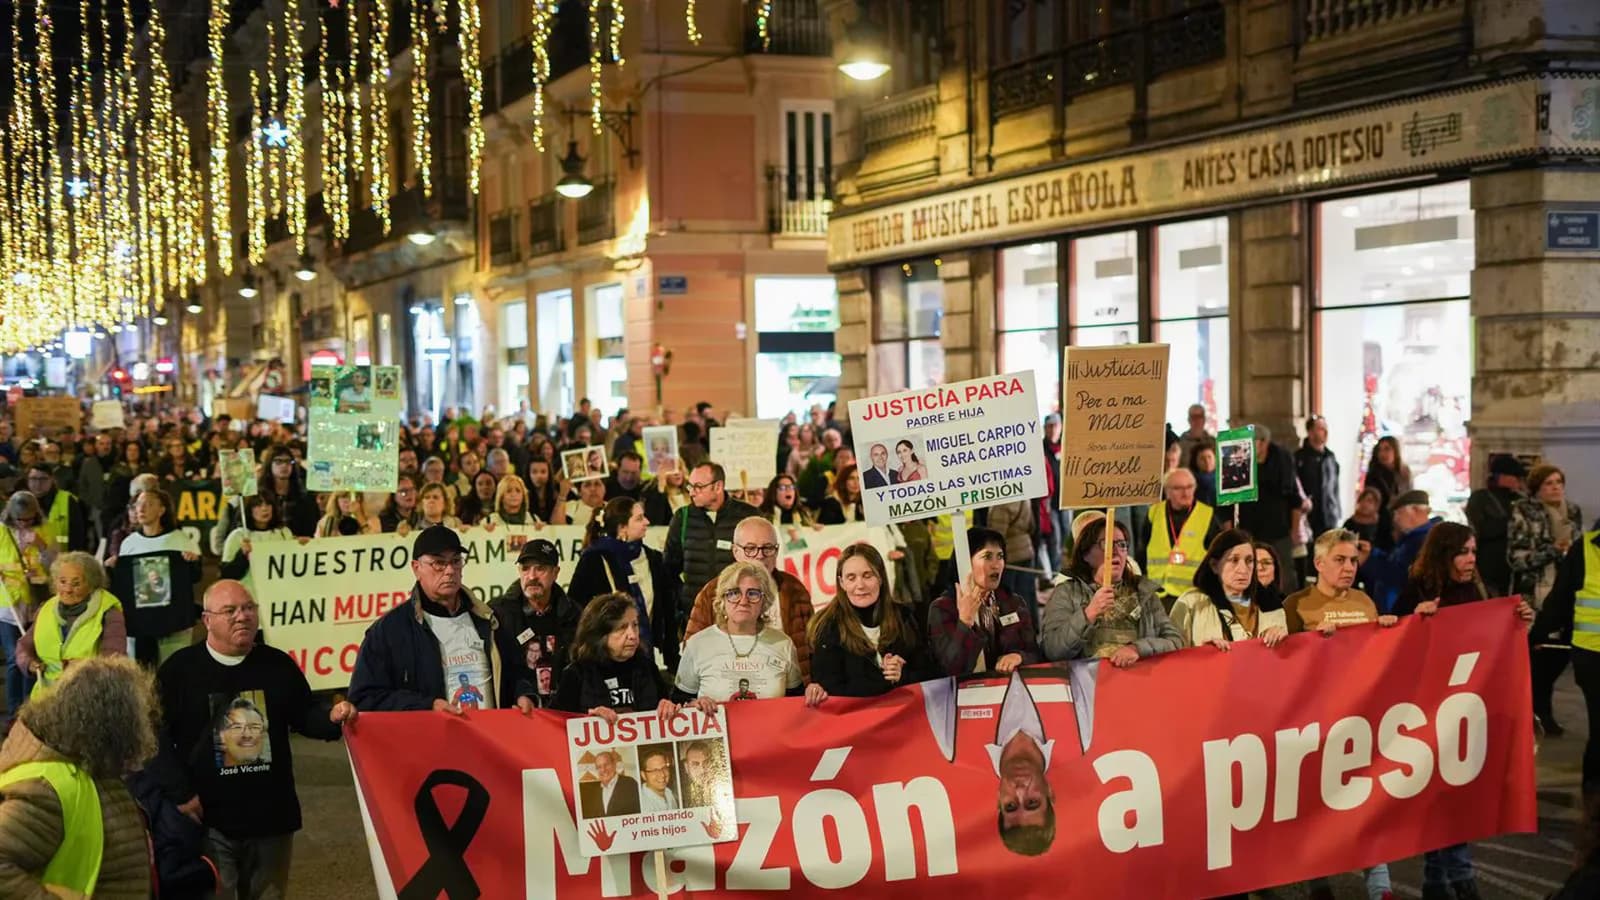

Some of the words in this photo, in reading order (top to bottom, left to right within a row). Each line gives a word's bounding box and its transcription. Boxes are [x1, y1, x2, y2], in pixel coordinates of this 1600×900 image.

[1182, 152, 1236, 191] ANTES
[912, 194, 999, 241] MUSICAL
[1007, 165, 1138, 224] ESPAÑOLA
[965, 378, 1024, 402] PARA
[1076, 390, 1102, 410] Per
[1107, 396, 1118, 407] a
[906, 412, 945, 428] PADRE
[948, 411, 955, 421] E
[958, 406, 985, 419] HIJA
[926, 433, 975, 452] MIGUEL
[977, 423, 1026, 443] CARPIO
[1028, 421, 1037, 434] Y
[941, 451, 976, 467] SARA
[978, 441, 1026, 463] CARPIO
[876, 491, 886, 503] Y
[889, 482, 935, 500] TODAS
[939, 477, 965, 491] LAS
[968, 465, 1032, 485] VICTIMAS
[889, 495, 947, 517] MAZÓN
[960, 481, 1024, 504] PRISIÓN
[268, 546, 409, 580] NUESTRO
[270, 598, 326, 627] HAN
[333, 591, 412, 621] MUER
[574, 711, 722, 747] JUSTICIA
[240, 764, 270, 773] Vicente
[522, 746, 958, 900] Mazón
[1093, 749, 1164, 853] a
[1202, 651, 1488, 871] presó
[622, 817, 640, 828] por
[642, 814, 655, 824] mi
[658, 810, 693, 823] marido
[631, 831, 638, 840] y
[641, 827, 659, 837] mis
[662, 824, 687, 837] hijos
